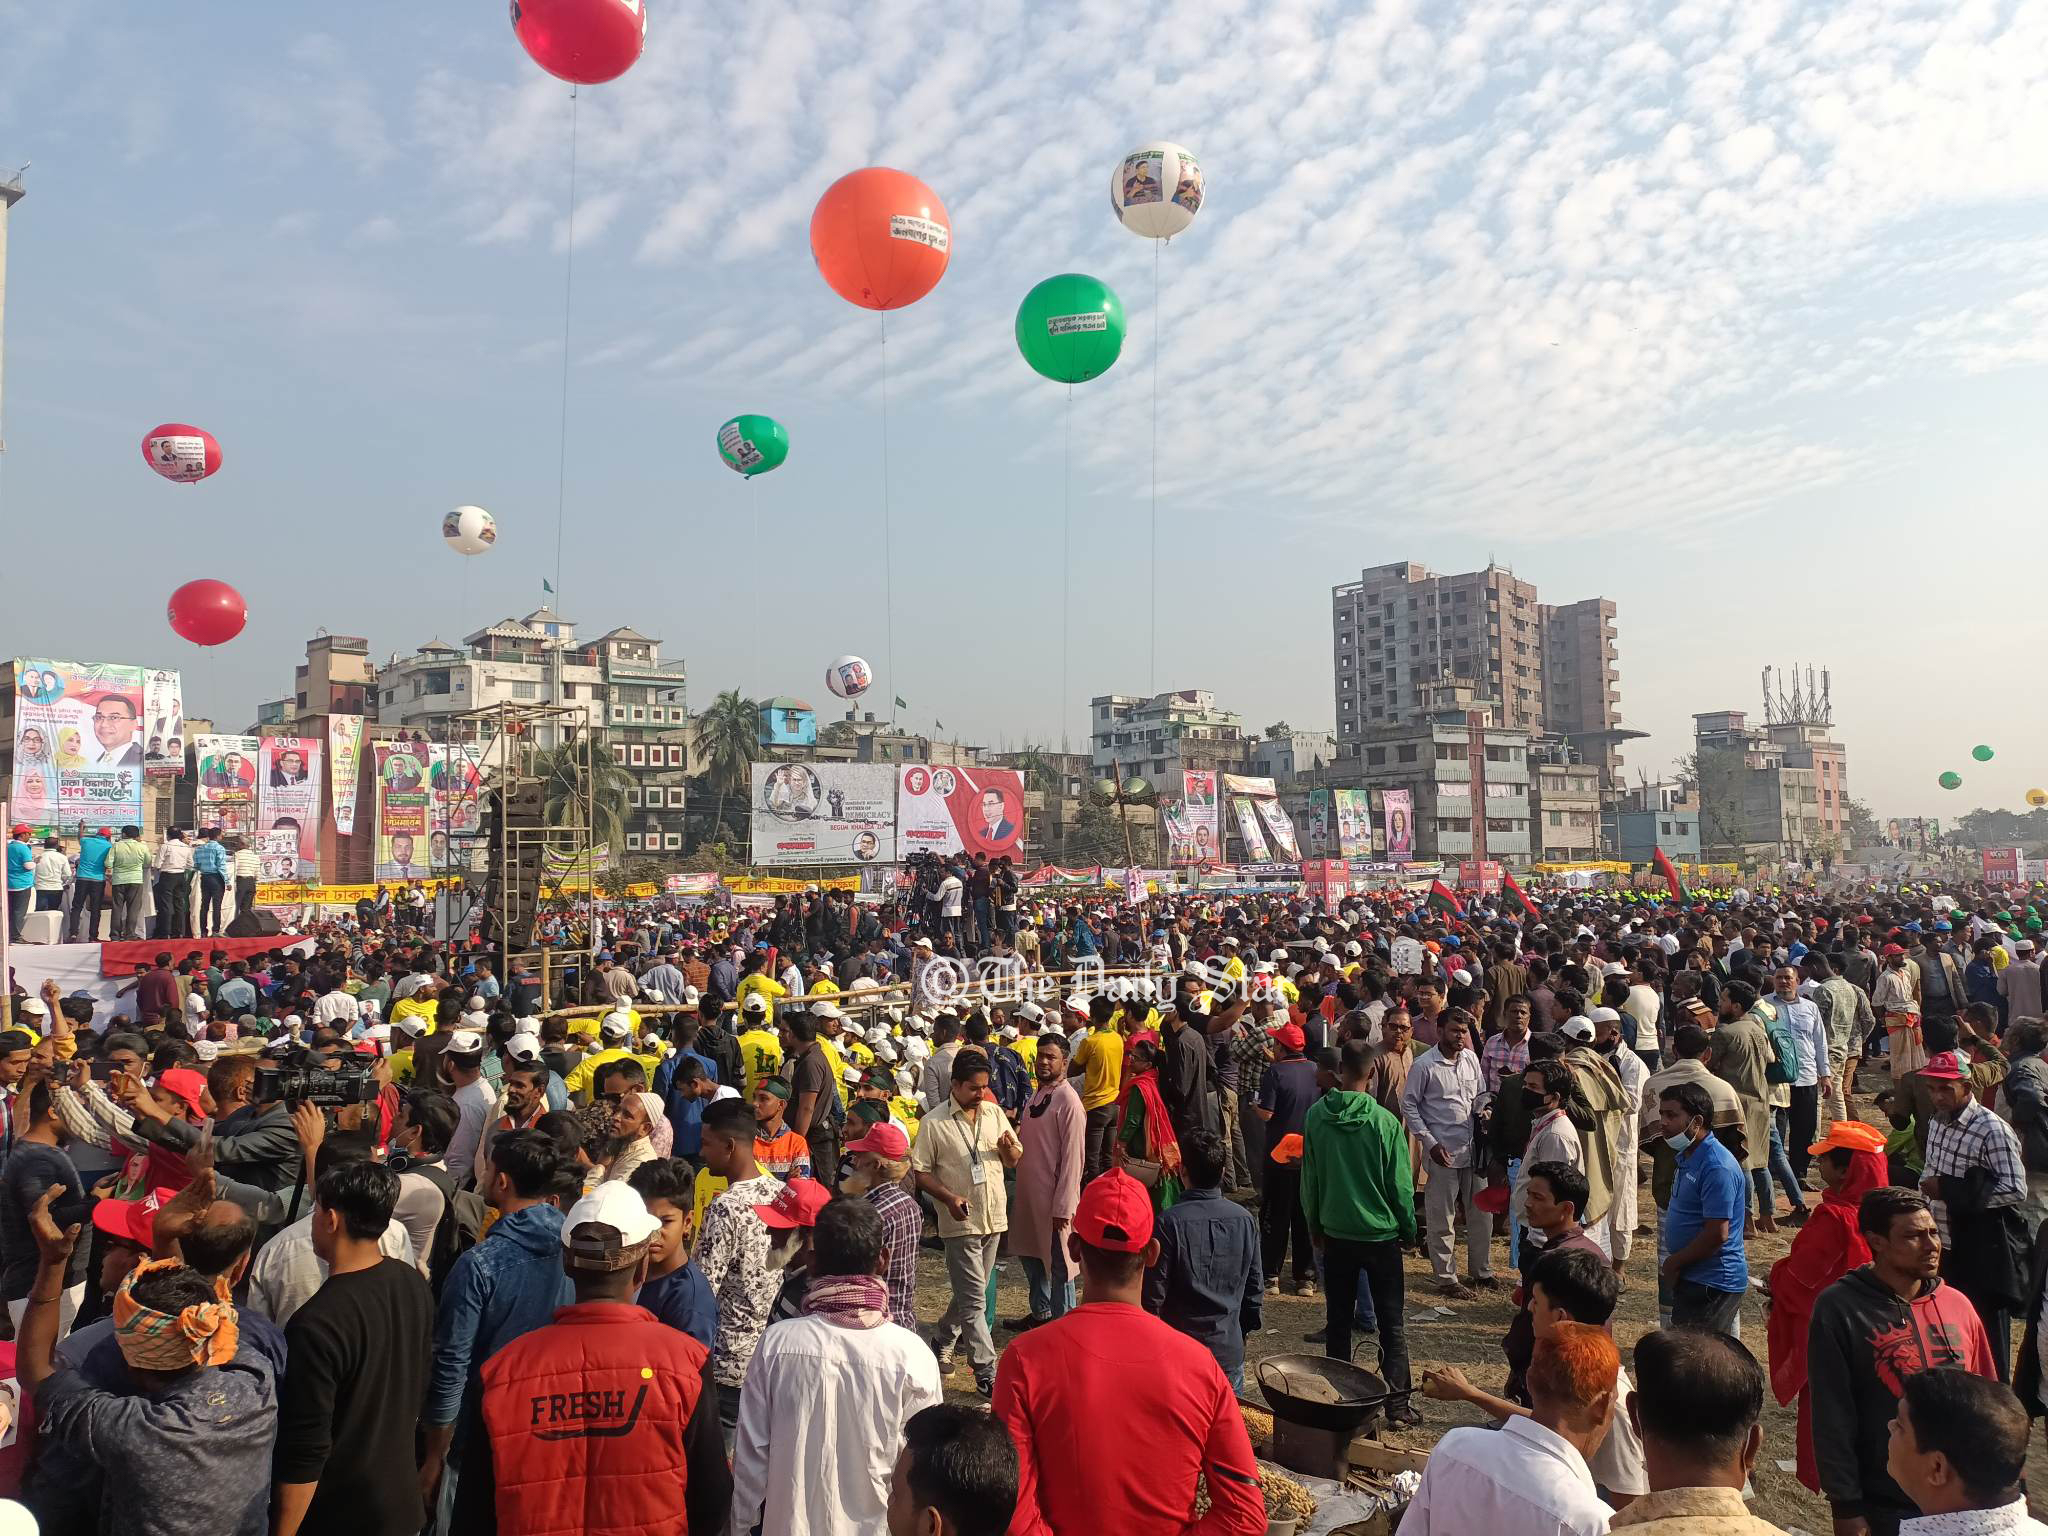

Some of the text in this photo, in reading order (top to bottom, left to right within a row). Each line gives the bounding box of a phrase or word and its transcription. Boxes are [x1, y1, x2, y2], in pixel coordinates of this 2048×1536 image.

[82, 779, 115, 788] বিভাগীয়
[60, 786, 133, 801] গণ সমাবেশ
[845, 811, 891, 819] DEMOCRACY
[747, 880, 772, 891] ঢাকা
[256, 886, 365, 901] শ্রমিক দল ঢাকা
[530, 1390, 626, 1425] FRESH
